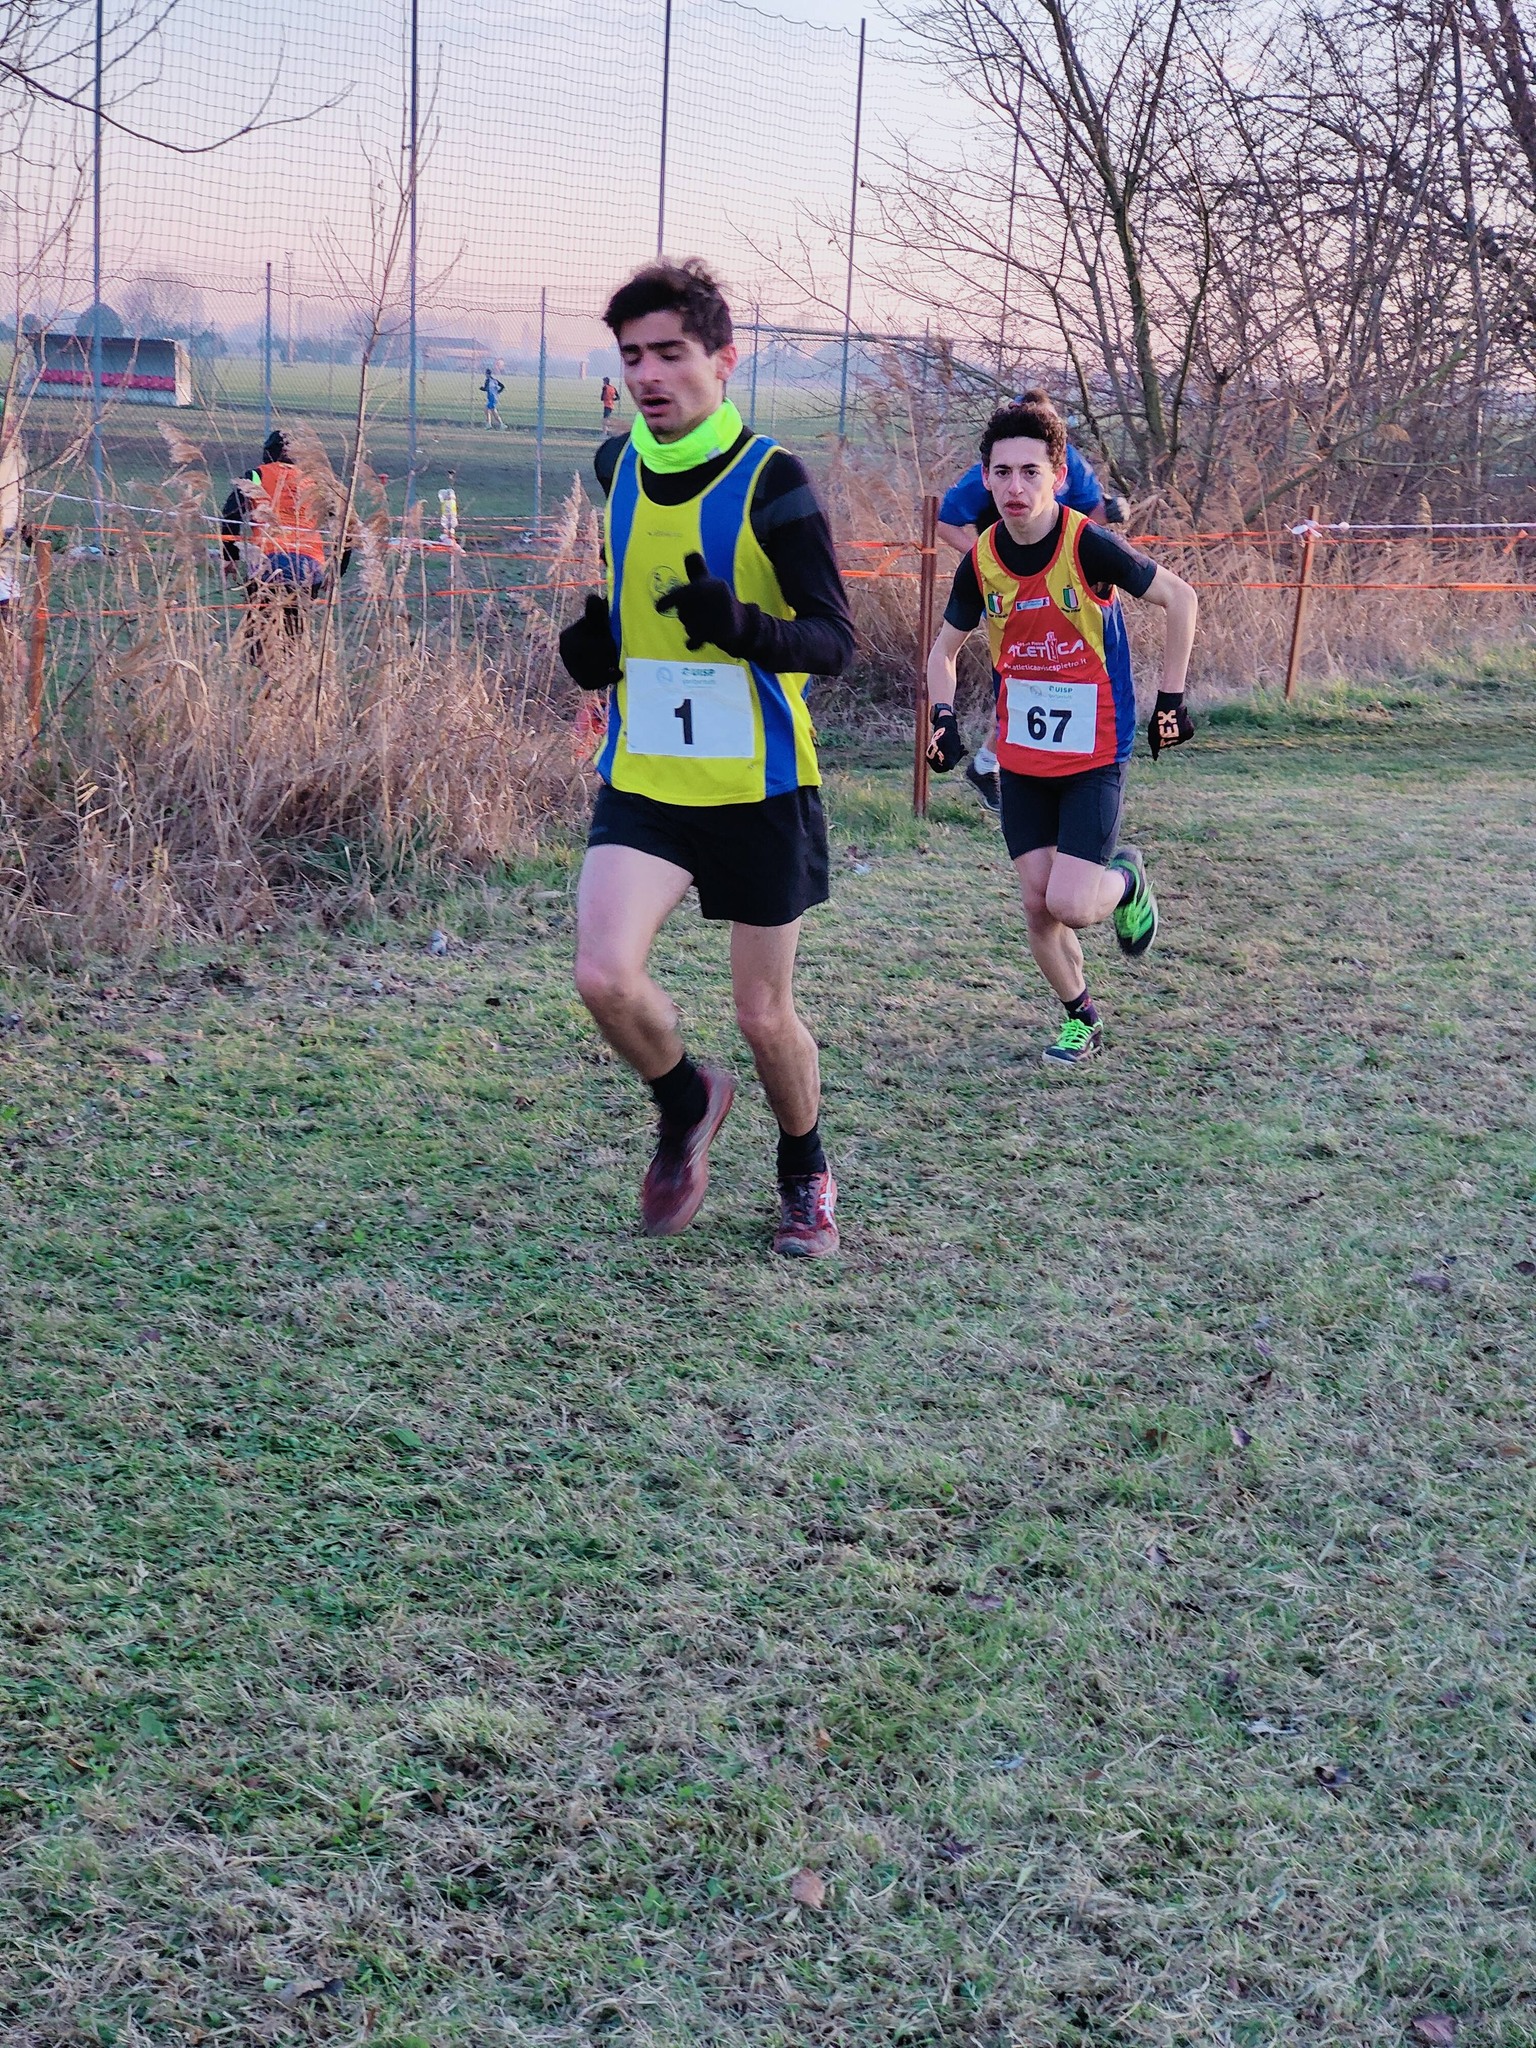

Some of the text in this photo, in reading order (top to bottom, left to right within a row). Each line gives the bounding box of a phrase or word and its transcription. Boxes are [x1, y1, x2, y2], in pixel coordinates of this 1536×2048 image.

[1007, 633, 1084, 662] ATLETICA
[674, 699, 693, 745] 1
[1027, 706, 1072, 742] 67
